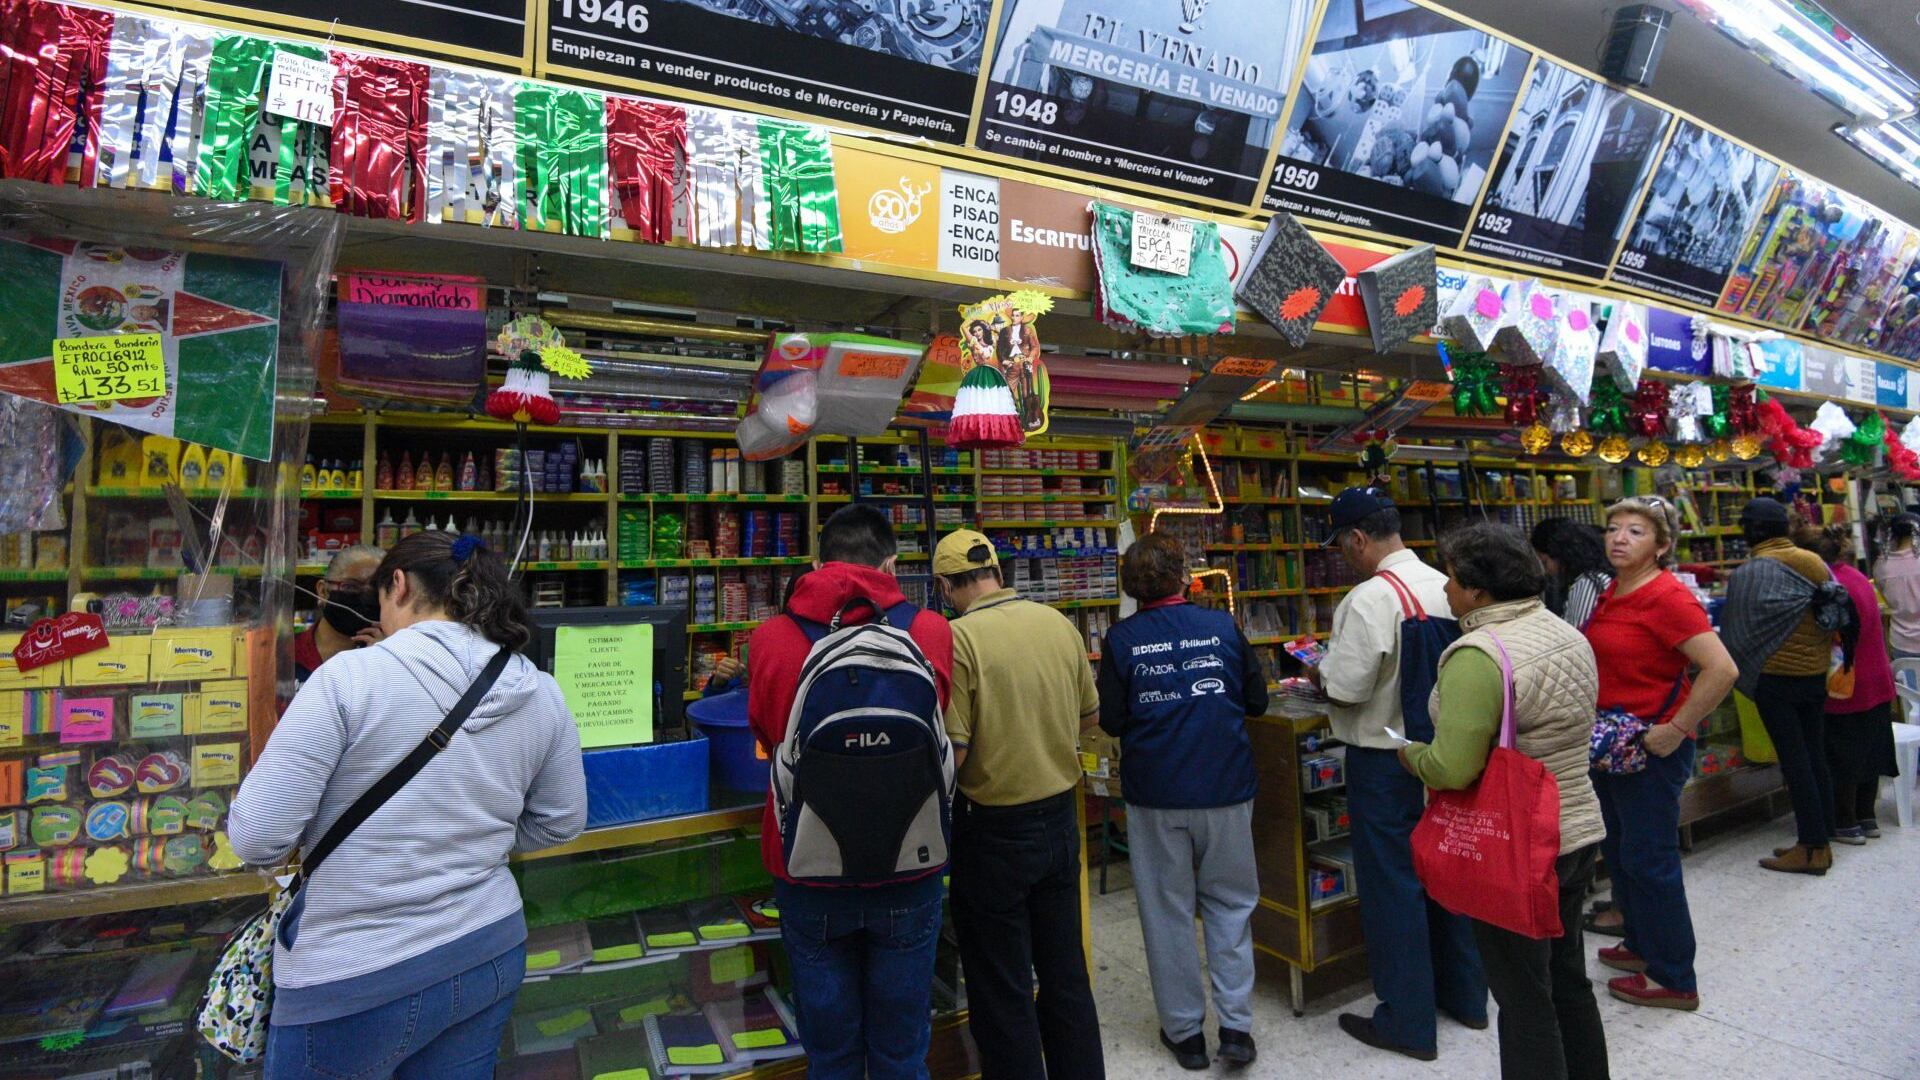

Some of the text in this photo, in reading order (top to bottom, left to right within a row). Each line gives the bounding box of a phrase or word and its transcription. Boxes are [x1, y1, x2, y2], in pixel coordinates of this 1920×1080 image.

[556, 0, 649, 33] 1946
[551, 38, 956, 133] Empiezan a vender productos de Mercería y Papelería.
[1049, 39, 1279, 115] MERCERÍA EL VENADO
[995, 90, 1058, 125] 1948
[985, 129, 1001, 142] Se
[1004, 135, 1047, 152] cambia
[1049, 144, 1061, 155] el
[1062, 148, 1102, 164] nombre
[1104, 156, 1111, 166] a
[1163, 168, 1173, 179] el
[1274, 162, 1320, 191] 1950
[875, 194, 903, 219] 90
[1263, 194, 1302, 211] Empiezan
[1303, 204, 1309, 213] a
[1311, 206, 1338, 220] vender
[1478, 212, 1512, 235] 1952
[1620, 250, 1647, 269] 1956
[357, 287, 471, 309] Diamantado
[73, 364, 101, 376] Rollo
[106, 361, 129, 374] 50
[1140, 639, 1211, 654] DIXON Pelikan
[1149, 663, 1175, 676] AZOR
[845, 732, 890, 748] FILA
